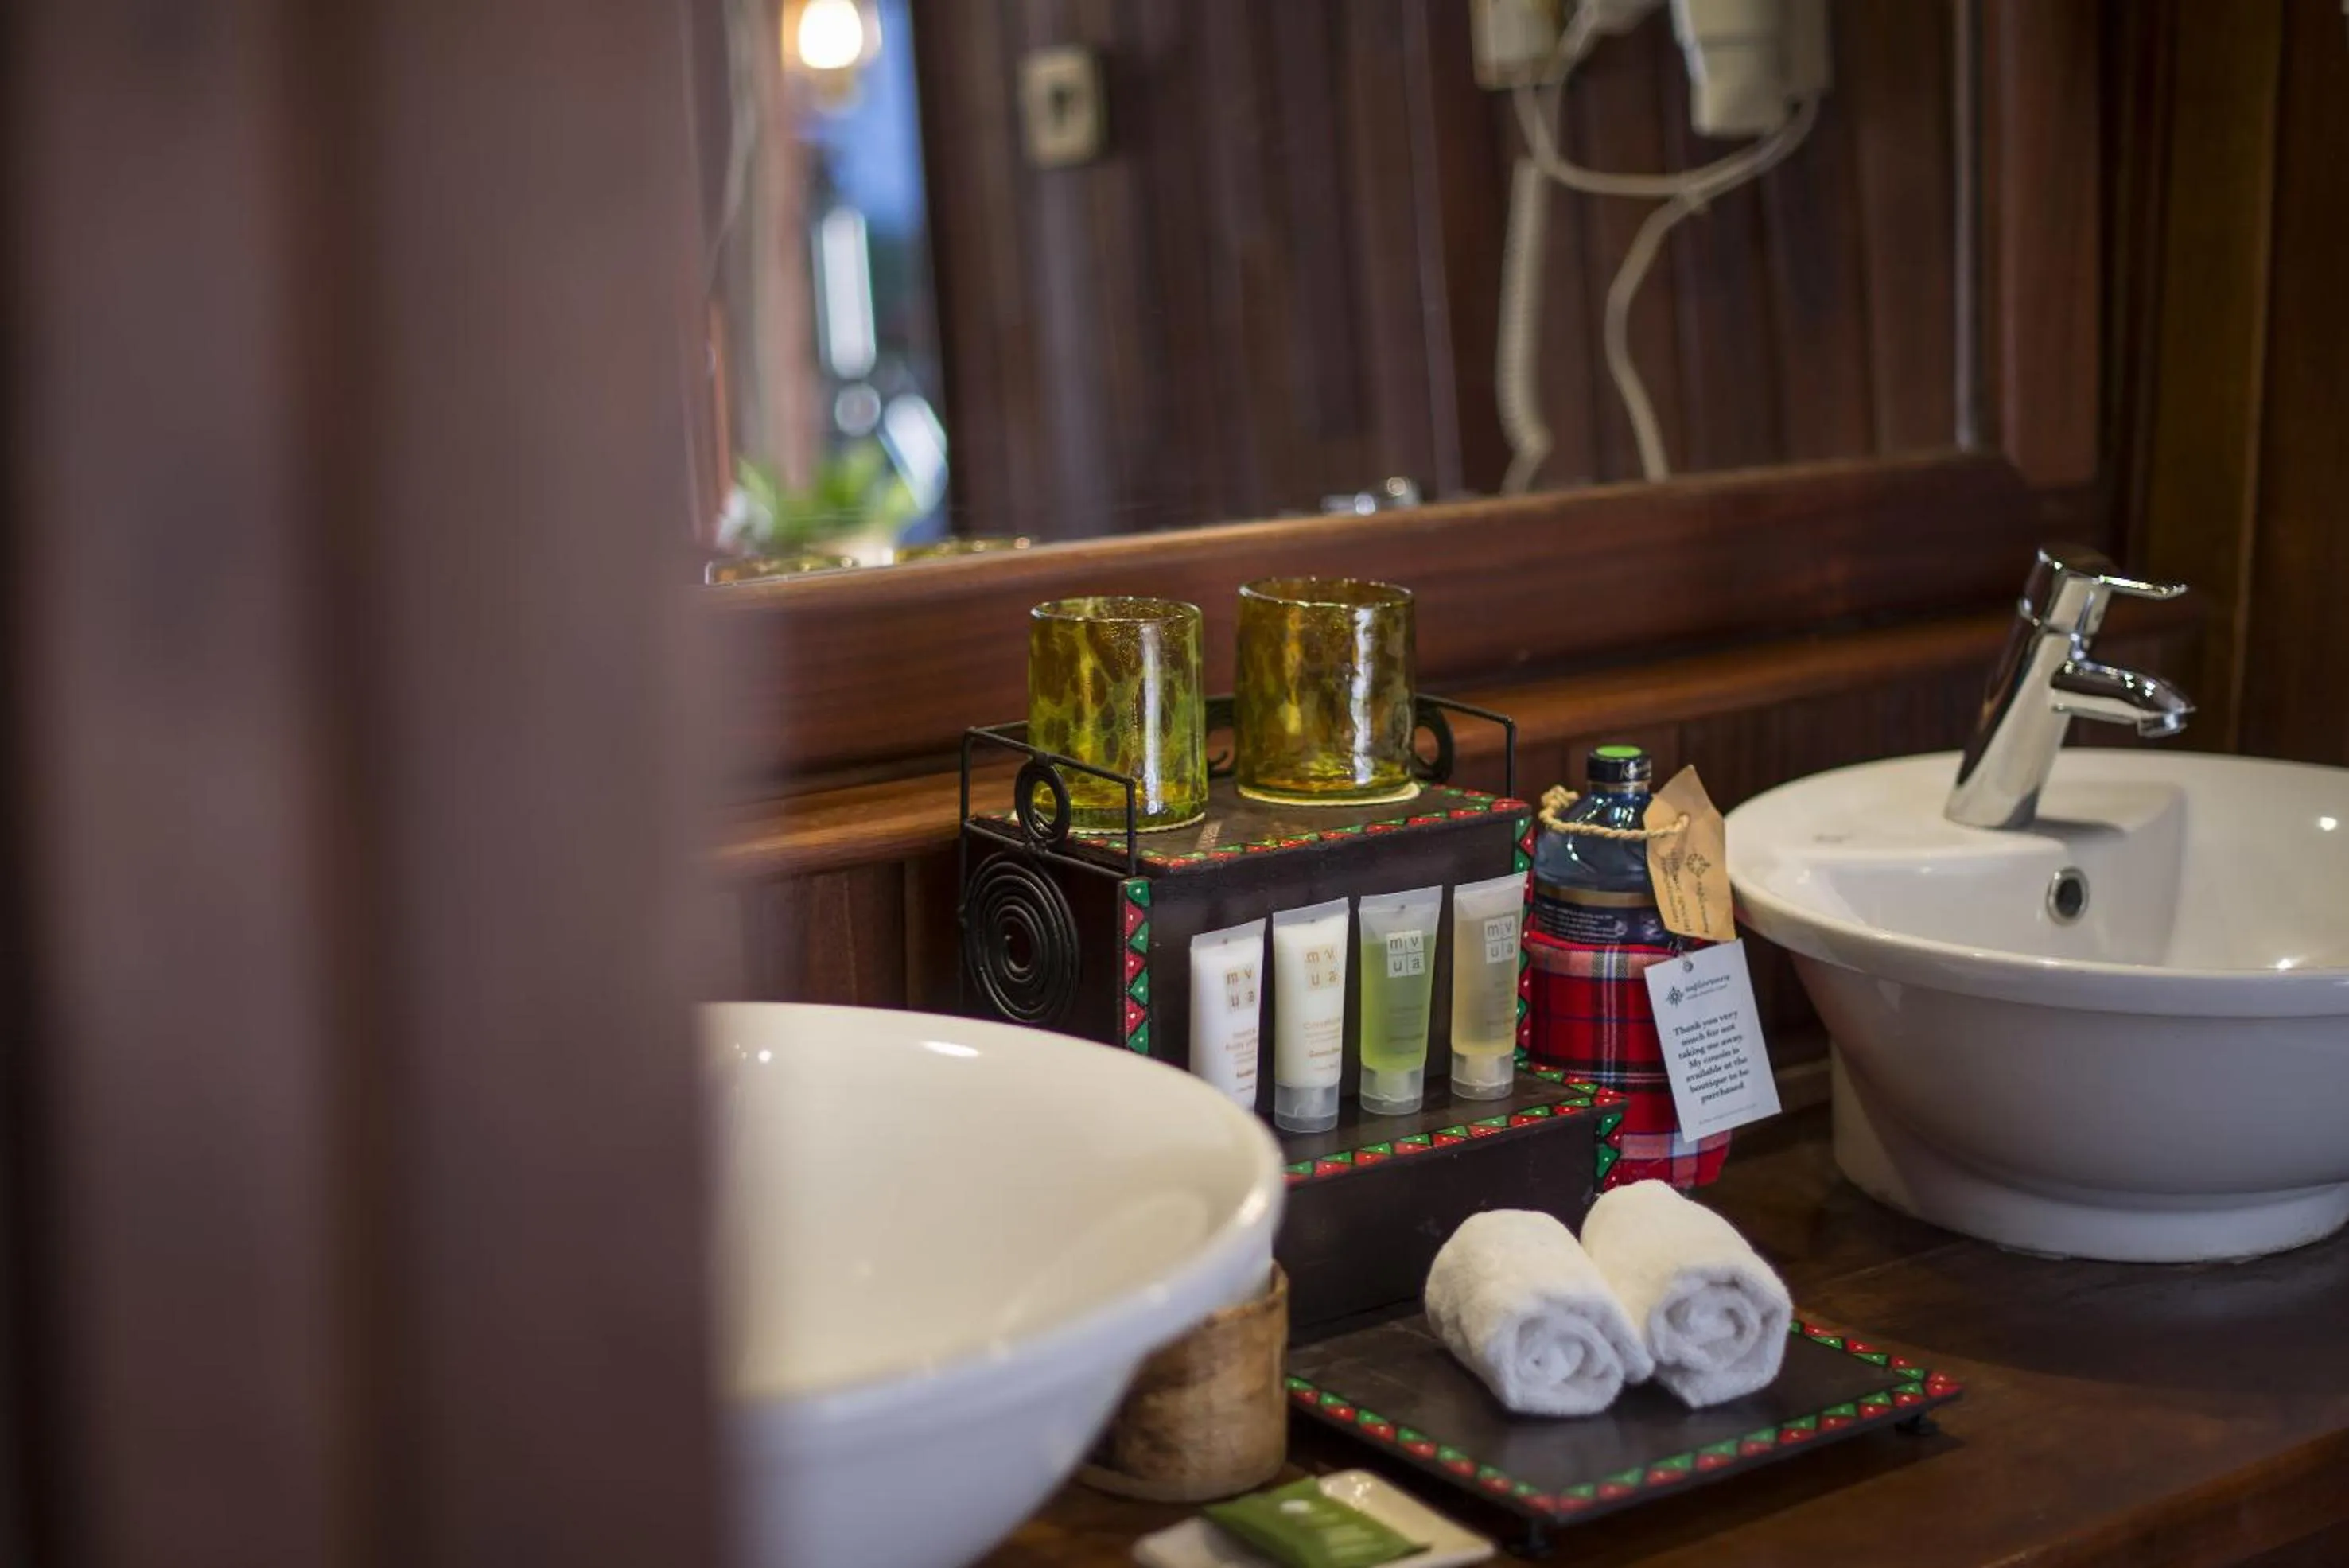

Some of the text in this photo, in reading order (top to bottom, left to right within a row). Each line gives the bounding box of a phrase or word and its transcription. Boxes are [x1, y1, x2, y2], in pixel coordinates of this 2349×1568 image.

[1673, 1010, 1737, 1036] Thank you very
[1678, 1046, 1705, 1060] taking
[1686, 1065, 1721, 1082] available
[1734, 1057, 1748, 1066] the
[1690, 1076, 1727, 1093] boutique
